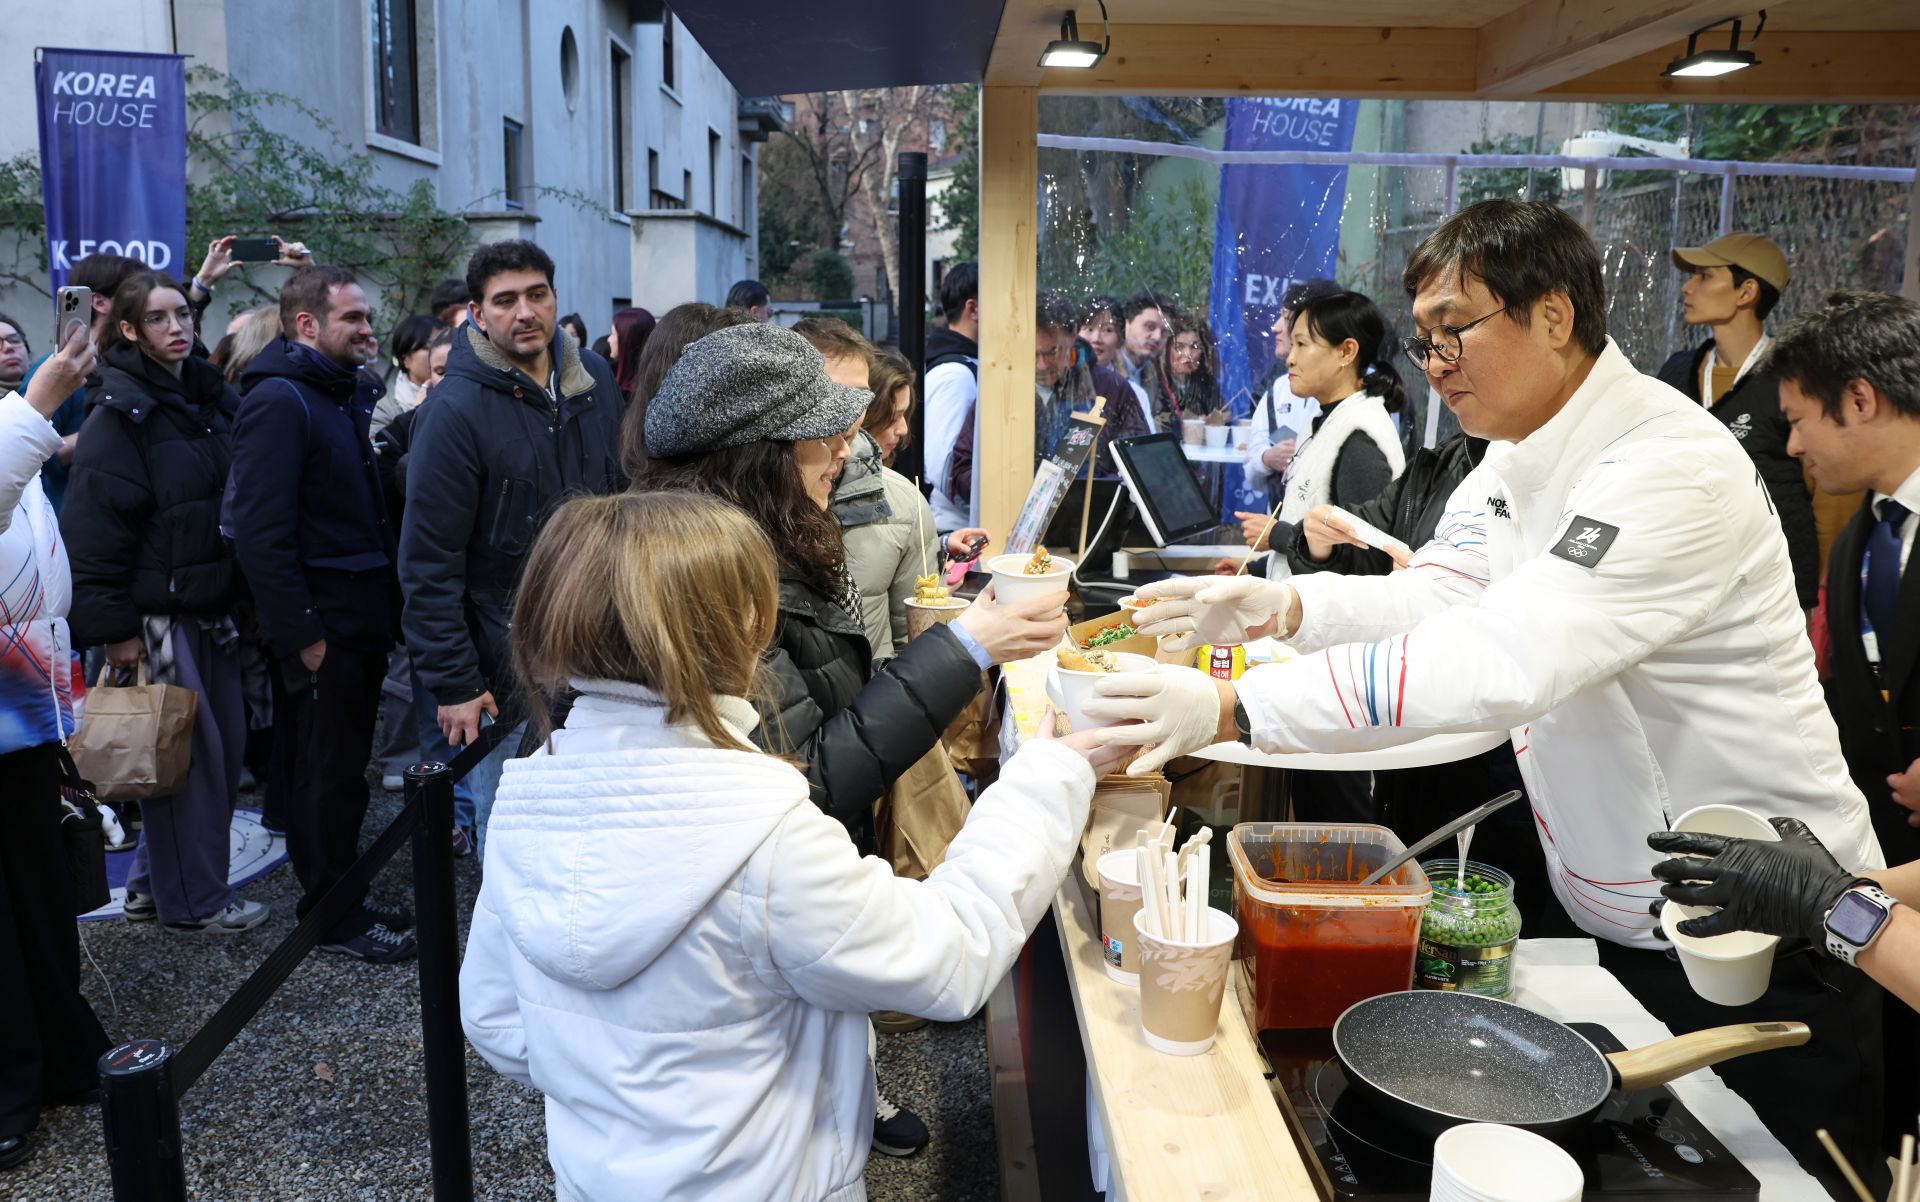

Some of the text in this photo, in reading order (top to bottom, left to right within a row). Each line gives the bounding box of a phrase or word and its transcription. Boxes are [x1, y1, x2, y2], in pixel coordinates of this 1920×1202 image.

[53, 71, 156, 99] KOREA
[53, 101, 158, 128] HOUSE
[1252, 109, 1338, 146] HOUSE
[51, 239, 172, 270] K-FOOD
[1245, 273, 1306, 305] EXI
